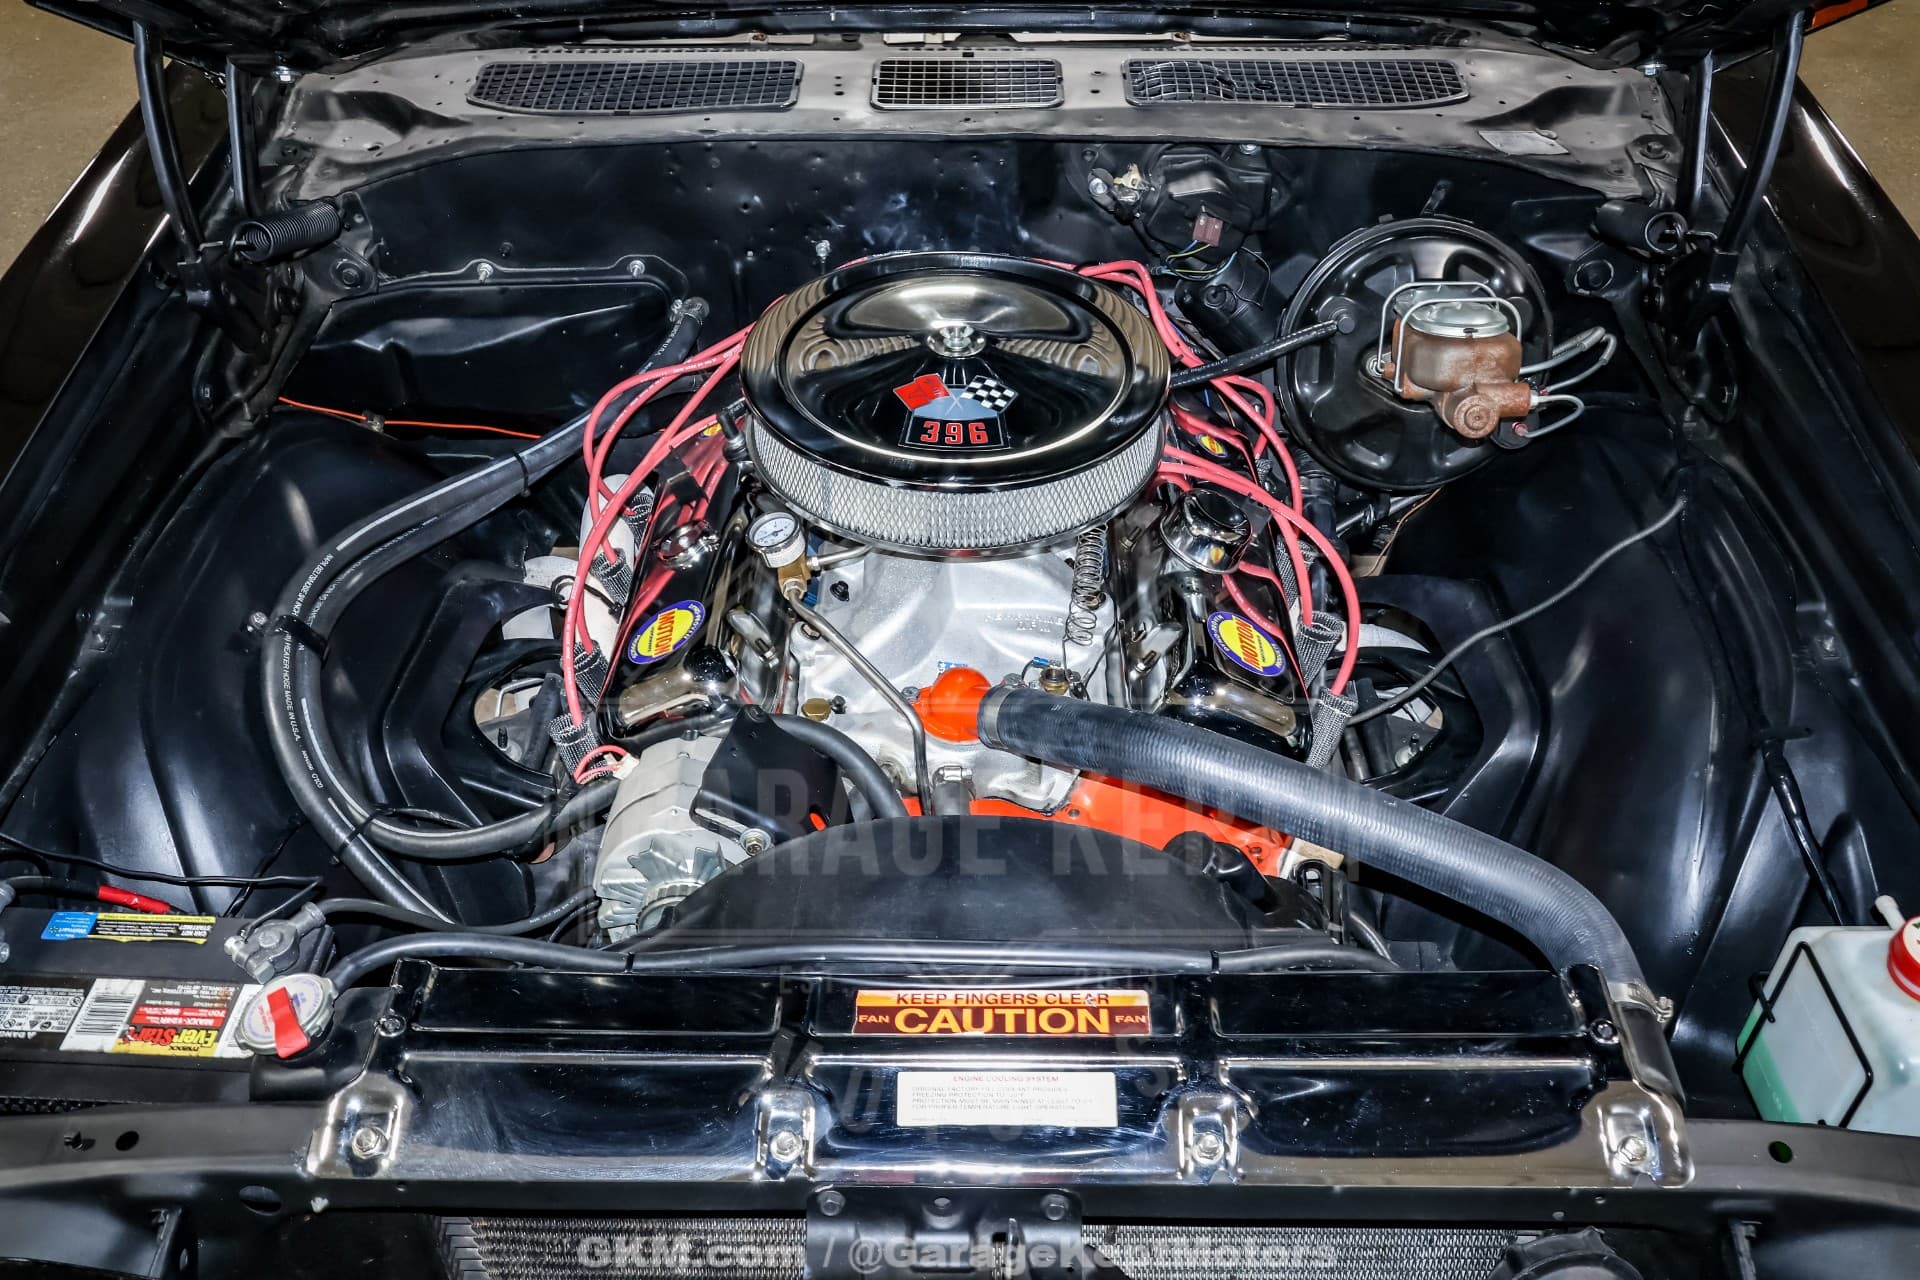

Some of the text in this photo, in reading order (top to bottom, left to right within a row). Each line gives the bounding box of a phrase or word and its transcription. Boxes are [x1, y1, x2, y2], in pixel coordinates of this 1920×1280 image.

[920, 421, 988, 444] 396
[653, 610, 676, 656] MOTION
[1235, 617, 1261, 669] MOTION
[282, 642, 292, 670] HEATER
[284, 690, 294, 711] MADE
[896, 993, 1110, 1006] KEEP FINGERS CLEAR
[858, 1008, 1147, 1034] FAN CAUTION FAN
[953, 1075, 983, 1083] ENGINE
